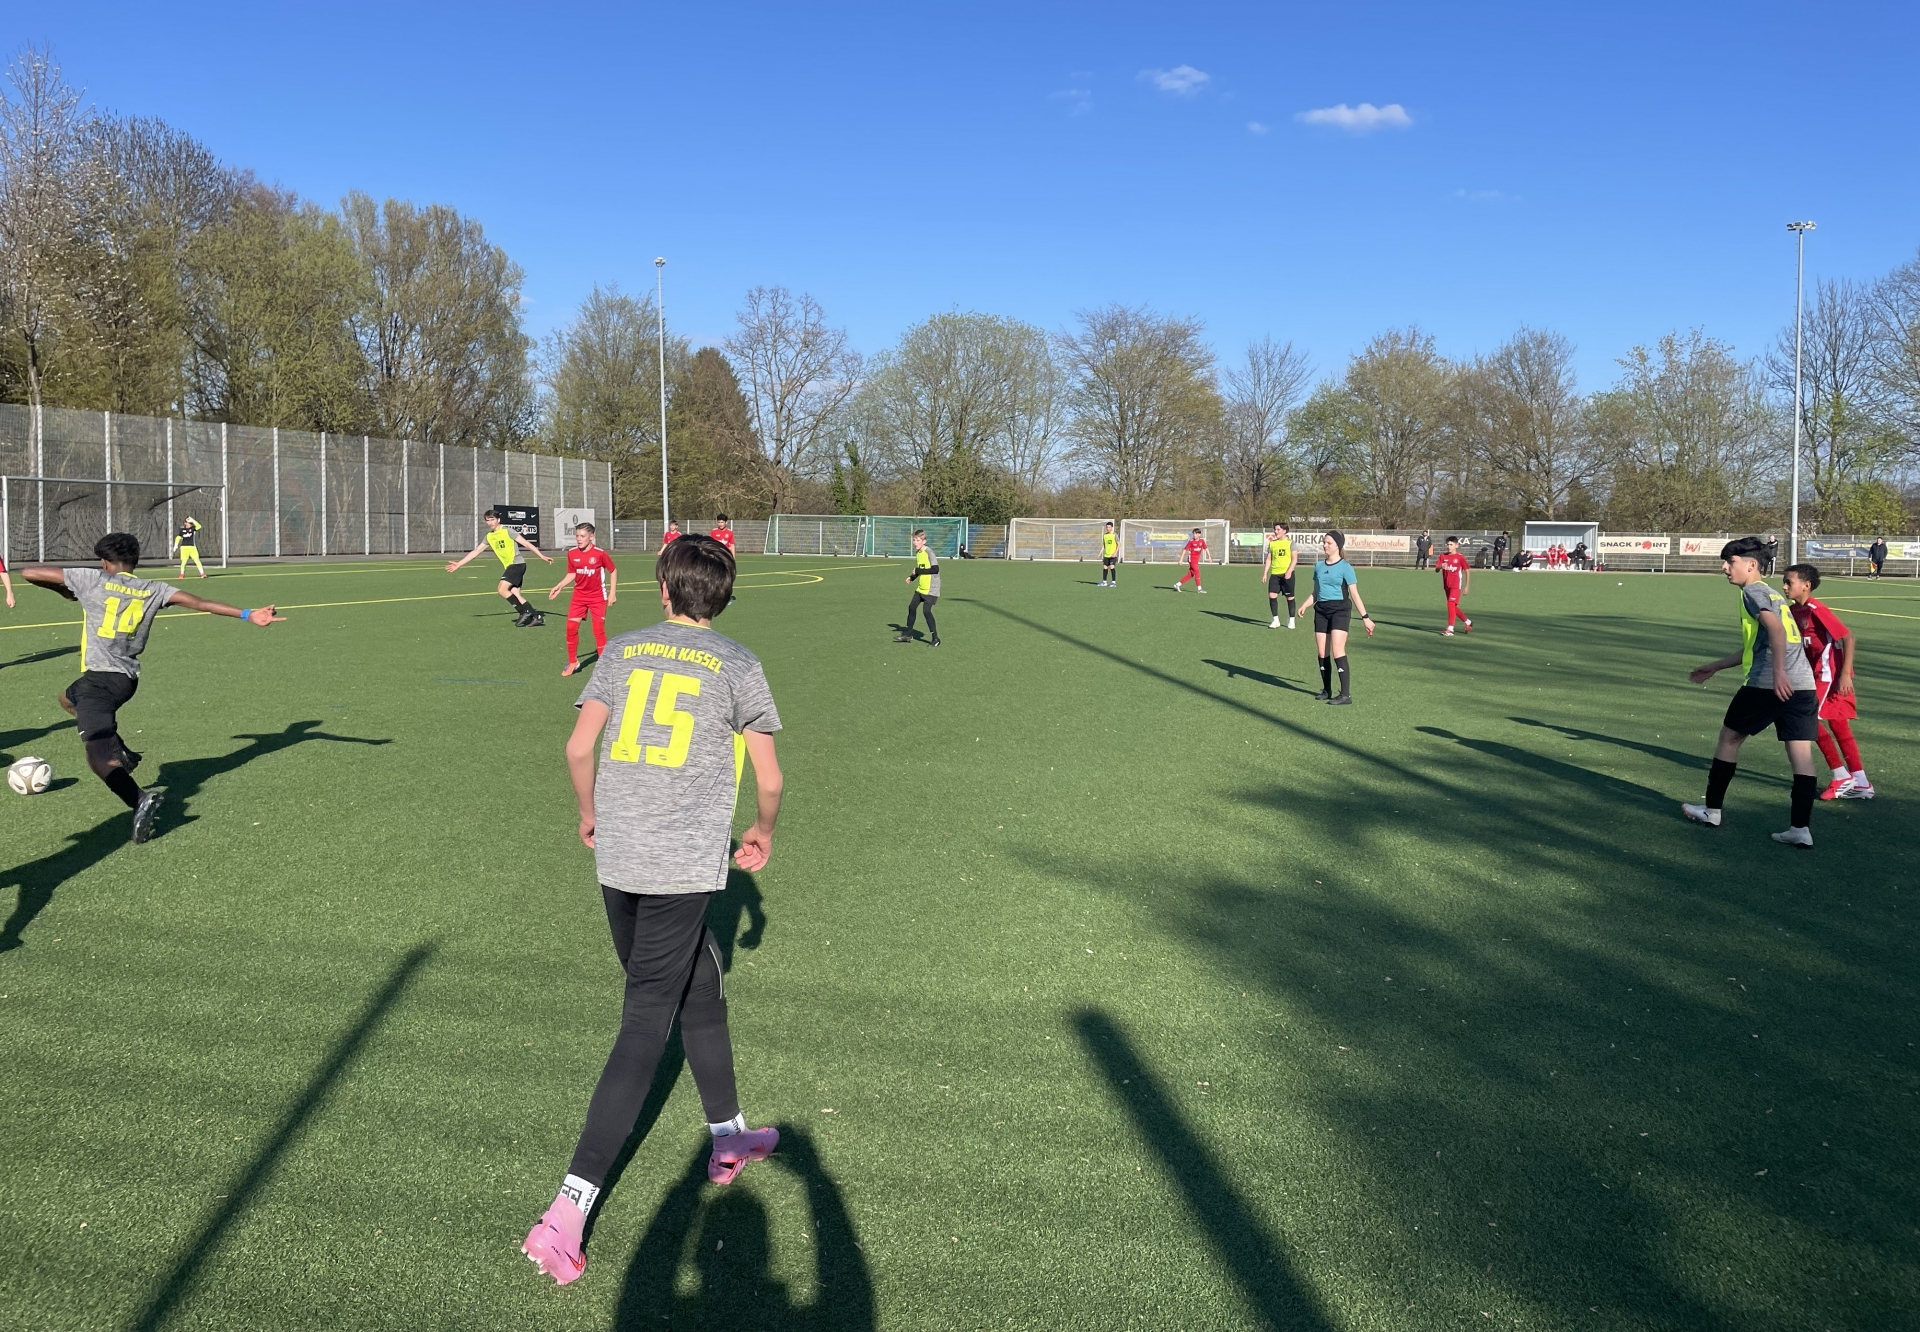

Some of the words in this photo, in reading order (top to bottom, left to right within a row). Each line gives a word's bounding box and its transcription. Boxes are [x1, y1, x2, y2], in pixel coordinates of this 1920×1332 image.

[1286, 534, 1325, 545] UREKA
[97, 596, 145, 639] 14
[623, 642, 677, 659] OLYMPIA
[677, 647, 723, 674] KASSEL
[610, 668, 701, 768] 15
